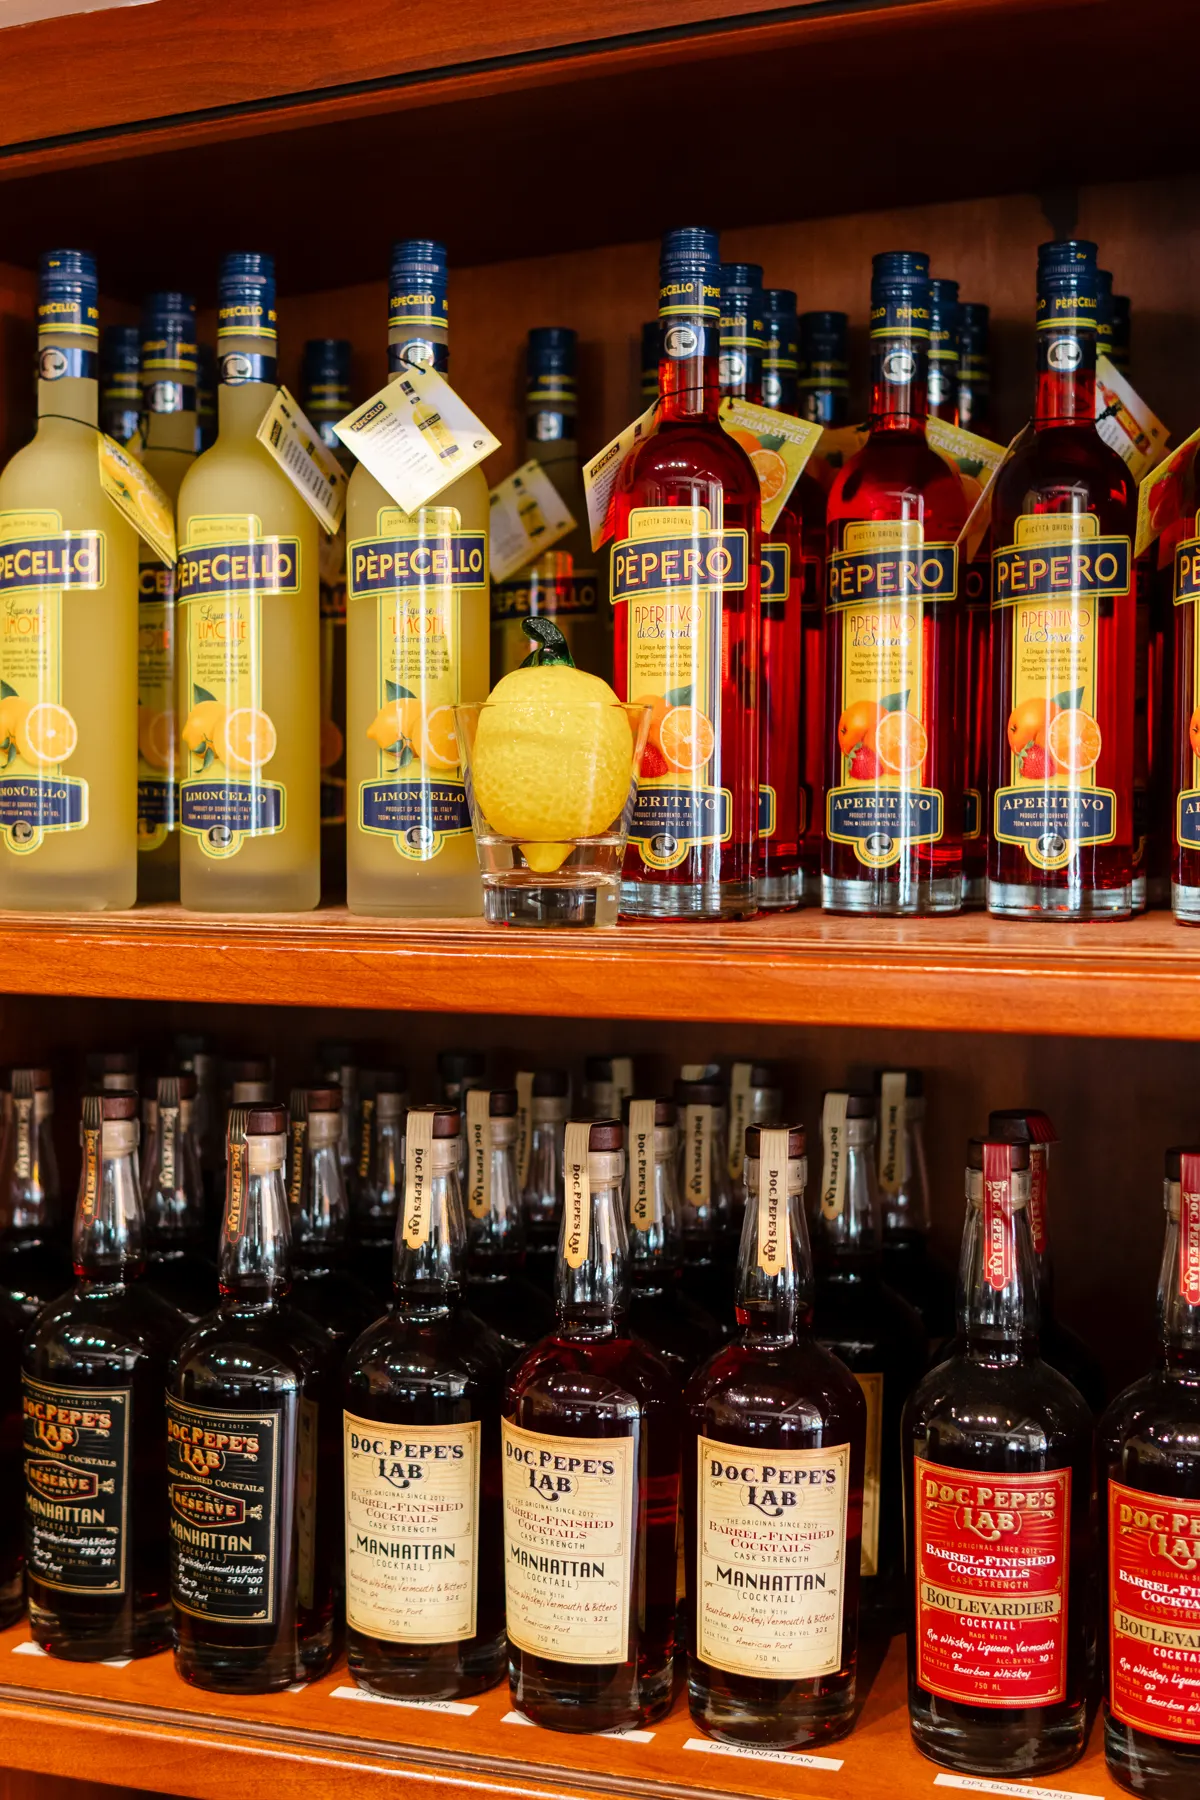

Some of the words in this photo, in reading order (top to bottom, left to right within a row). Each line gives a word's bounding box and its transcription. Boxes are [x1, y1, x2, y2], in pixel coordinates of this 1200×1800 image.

[734, 416, 771, 434] ITALIAN
[0, 548, 94, 580] PECELLO
[356, 547, 482, 582] PÈPECELLO
[616, 546, 732, 588] PÈPERO
[998, 553, 1118, 593] PÈPERO
[830, 558, 944, 599] PÈPERO
[374, 789, 465, 802] LIMONCELLO
[636, 796, 717, 810] ERITIVO
[1003, 797, 1104, 811] APERITIVO
[634, 1200, 646, 1219] LAB
[408, 1213, 422, 1236] LAB
[568, 1230, 582, 1255] LAB
[763, 1236, 776, 1262] LAB
[988, 1250, 1003, 1275] LAB
[1184, 1266, 1200, 1290] LAB
[38, 1420, 75, 1452] LAB
[68, 1454, 117, 1467] COCKTAILS
[183, 1443, 221, 1477] LAB
[30, 1468, 90, 1490] RESERVE
[379, 1458, 423, 1489] LAB
[215, 1480, 264, 1493] COCKTAILS
[375, 1490, 404, 1498] ORIGINAL
[529, 1469, 572, 1501] LAB
[26, 1492, 105, 1524] MANHATTAN
[175, 1492, 236, 1516] RESERVE
[351, 1490, 464, 1512] BARREL-FINISHED
[526, 1500, 552, 1511] ORIGINAL
[556, 1507, 576, 1515] SINCE
[748, 1486, 797, 1516] LAB
[366, 1508, 438, 1523] COCKTAILS
[506, 1500, 614, 1529] BARREL-FINISHED
[964, 1508, 1015, 1541] LAB
[170, 1517, 252, 1551] MANHATTAN
[369, 1521, 387, 1530] CASK
[392, 1524, 437, 1532] STRENGTH
[518, 1518, 588, 1540] COCKTAILS
[709, 1521, 834, 1542] BARREL-FINISHED
[356, 1533, 455, 1560] MANHATTAN
[520, 1532, 536, 1542] CASK
[541, 1538, 585, 1550] STRENGTH
[730, 1537, 811, 1552] COCKTAILS
[958, 1542, 993, 1551] ORIGINAL
[376, 1558, 424, 1571] COCKTAIL
[511, 1544, 605, 1578] MANHATTAN
[734, 1551, 756, 1561] CASK
[762, 1555, 809, 1563] STRENGTH
[926, 1543, 1055, 1567] BARREL-FINISHED
[527, 1572, 572, 1588] COCKTAIL
[716, 1564, 826, 1591] MANHATTAN
[948, 1563, 1030, 1579] COCKTAILS
[1152, 1569, 1188, 1580] ORIGINAL
[444, 1582, 467, 1591] Bitters
[950, 1576, 973, 1586] CASK
[979, 1579, 1029, 1588] STRENGTH
[592, 1602, 618, 1611] Bitters
[743, 1591, 795, 1603] COCKTAIL
[927, 1586, 1054, 1616] BOULEVARDIER
[705, 1603, 731, 1618] Bourbon
[767, 1615, 804, 1626] Vermouth
[814, 1613, 835, 1624] Bitters
[960, 1617, 1016, 1630] COCKTAIL
[554, 1625, 570, 1633] Port
[736, 1636, 771, 1648] American
[927, 1628, 938, 1641] Rye
[978, 1642, 1014, 1657] Liqueur,
[1016, 1640, 1055, 1651] Vermouth
[953, 1664, 990, 1677] Bourbon
[1120, 1657, 1131, 1671] Rye
[1146, 1695, 1184, 1711] Bourbon
[710, 1744, 733, 1753] DPL
[736, 1748, 814, 1764] MANHATTAN
[991, 1783, 1073, 1800] BOULEVARD
